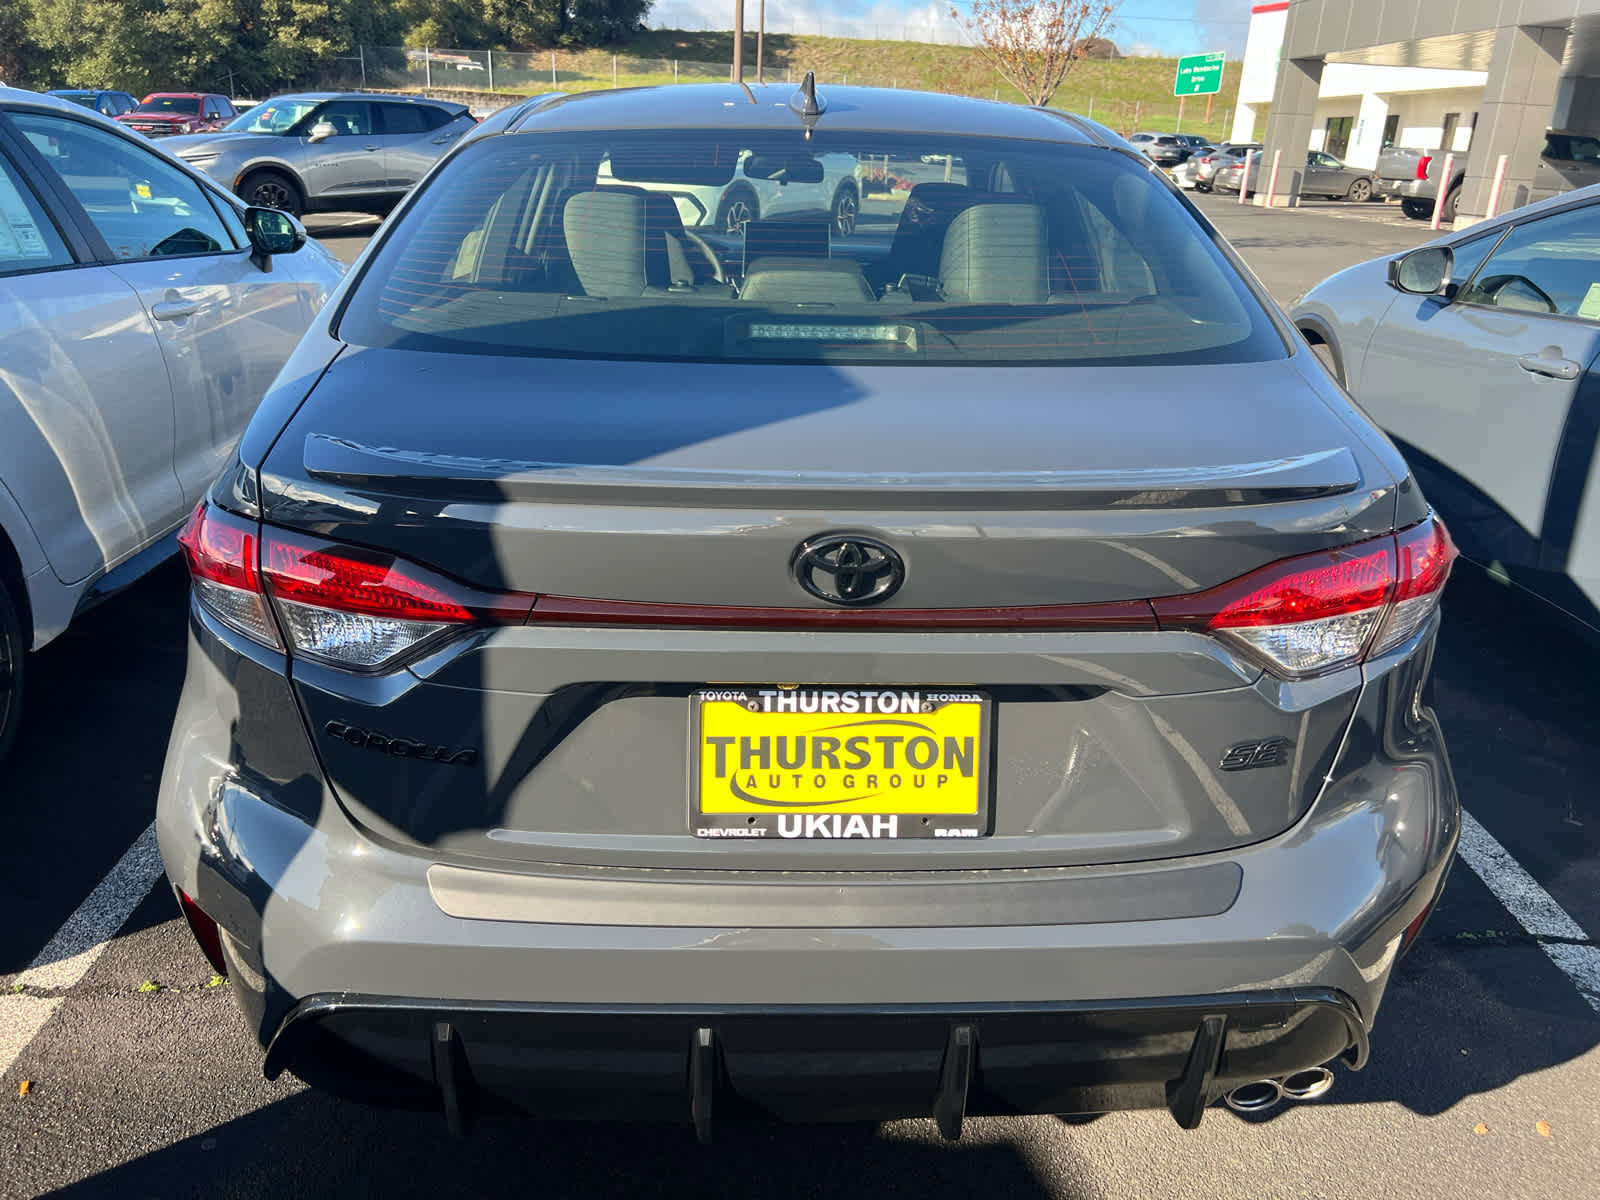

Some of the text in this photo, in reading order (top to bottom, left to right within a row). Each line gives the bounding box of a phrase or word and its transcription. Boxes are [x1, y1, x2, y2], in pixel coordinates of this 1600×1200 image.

[699, 691, 748, 701] TOYOTA
[758, 690, 920, 713] THURSTON
[926, 693, 983, 702] HONDA
[324, 719, 478, 767] COROLLA
[706, 735, 974, 778] THURSTON
[1218, 736, 1288, 771] SE
[745, 774, 948, 789] AUTO GROUP
[697, 828, 767, 837] CHEVROLET
[777, 814, 898, 838] UKIAH
[934, 828, 979, 837] RAM
